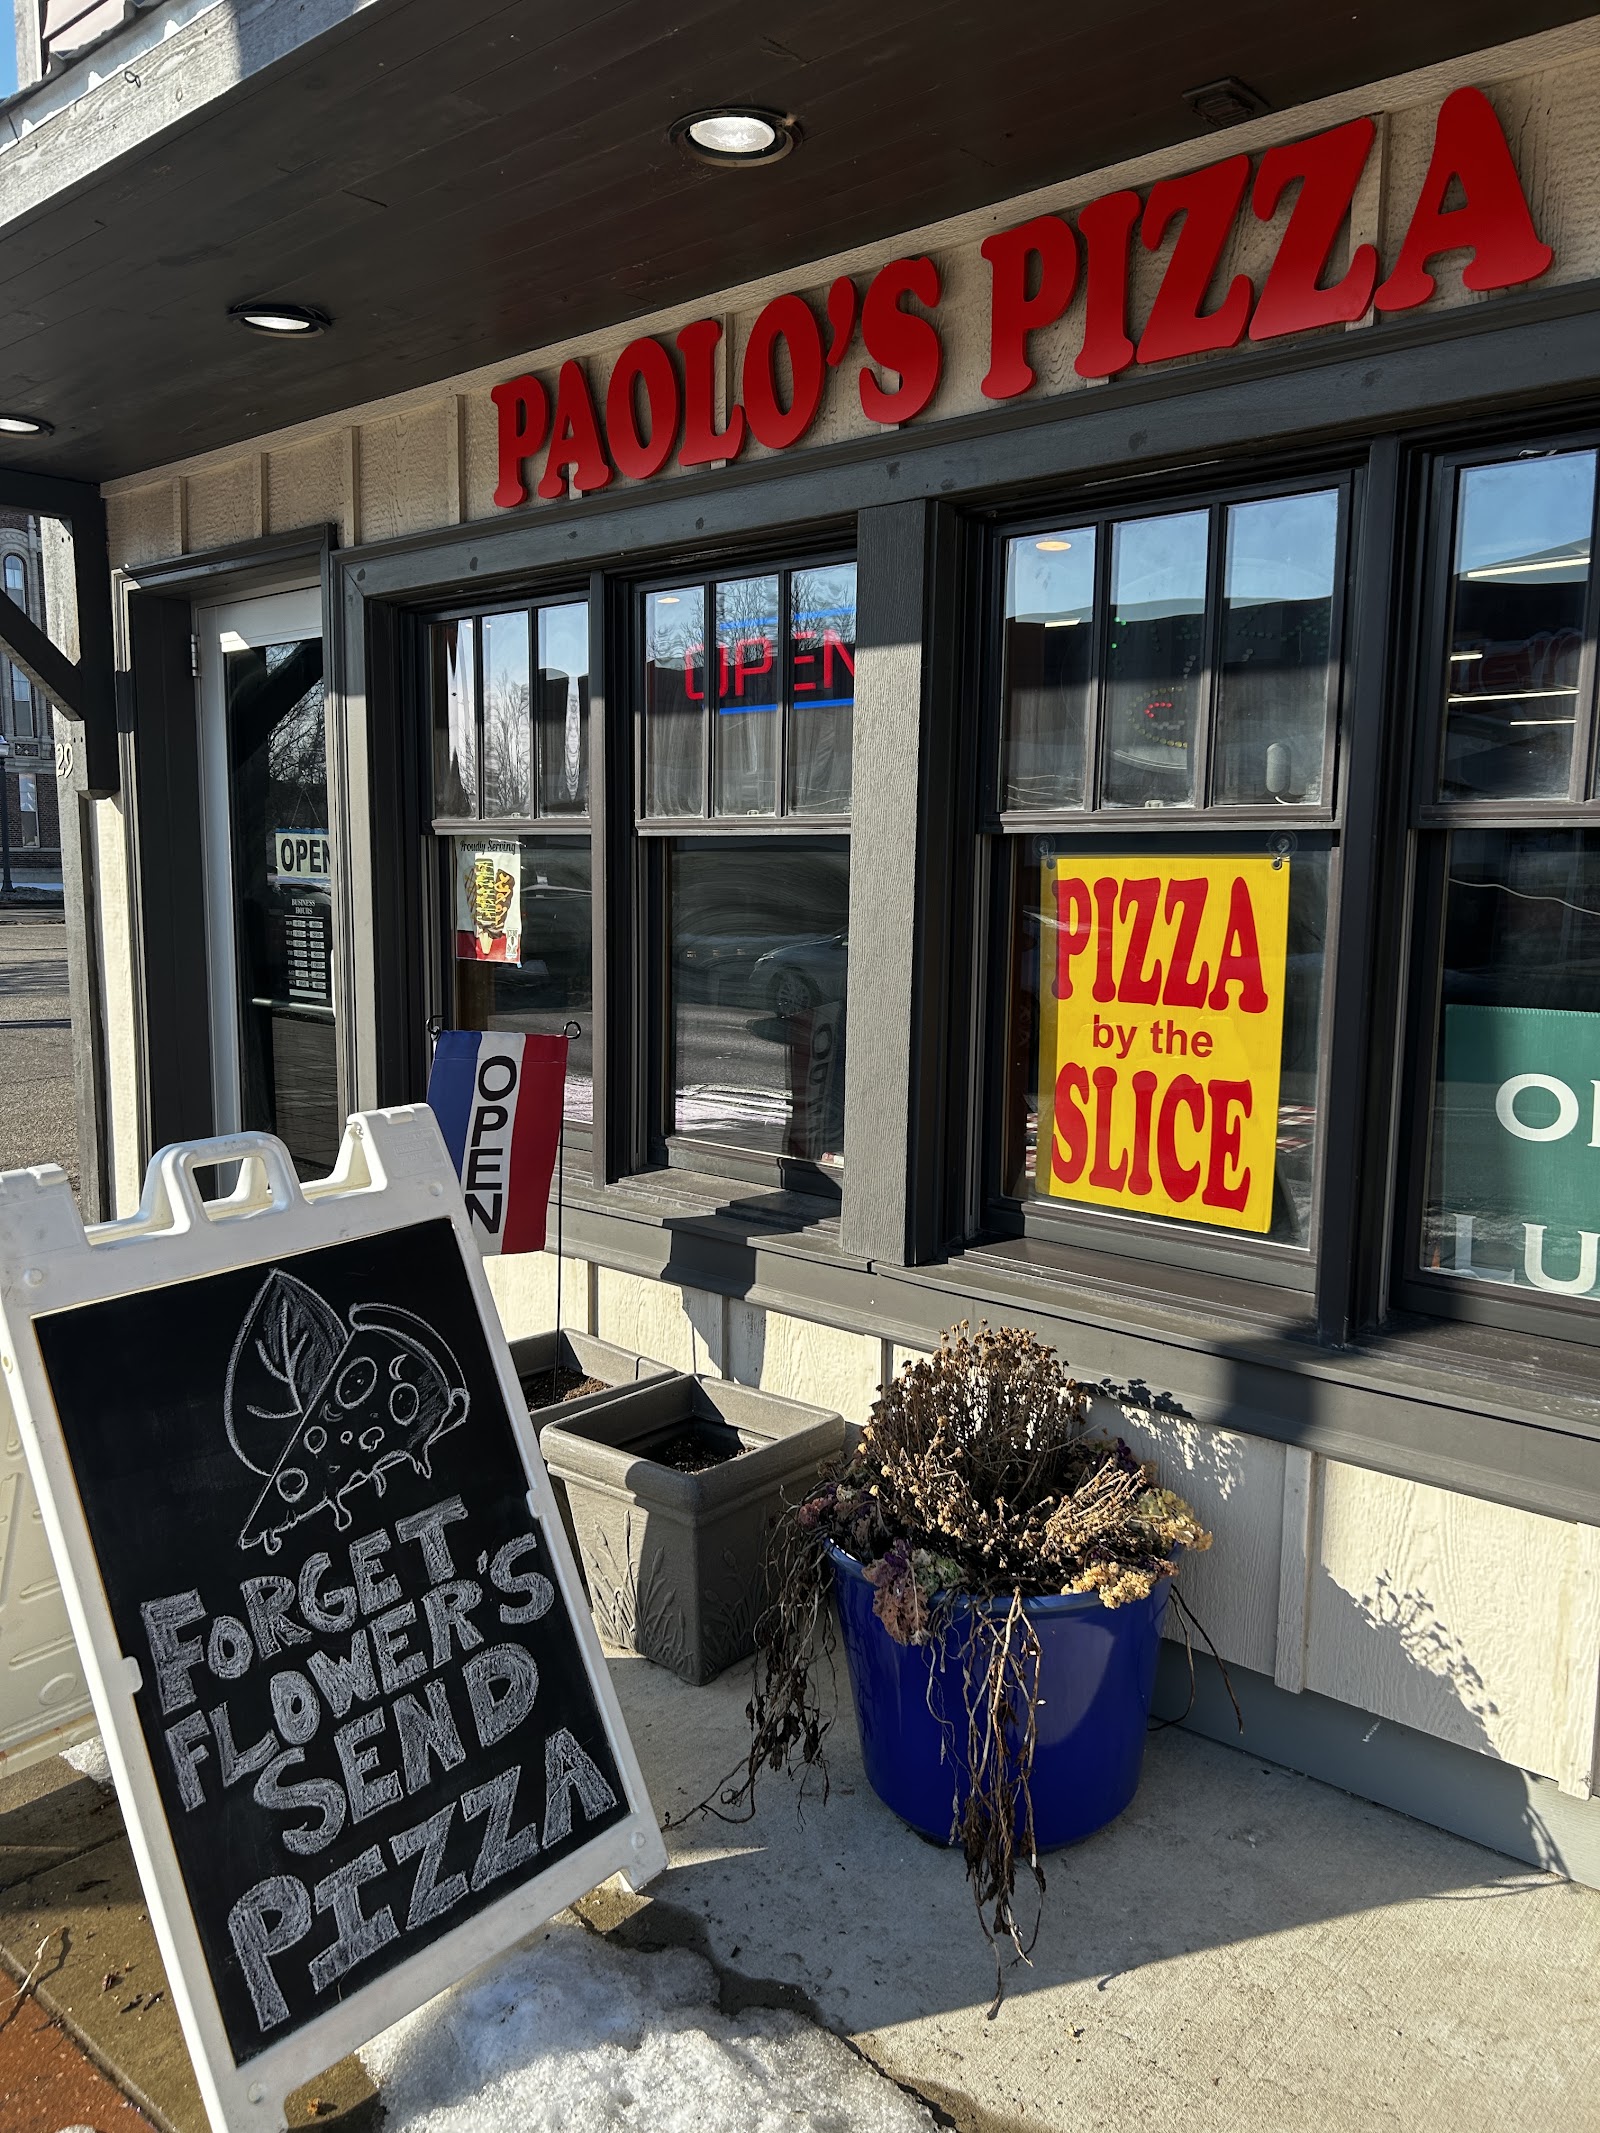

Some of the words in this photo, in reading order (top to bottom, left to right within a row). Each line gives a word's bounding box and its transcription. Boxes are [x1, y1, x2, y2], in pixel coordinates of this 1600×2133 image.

[490, 256, 943, 508] PAOLO'S
[981, 86, 1553, 400] PIZZA
[684, 628, 855, 700] OPEN
[56, 743, 74, 779] 29
[460, 840, 487, 854] Proudly
[487, 840, 516, 855] Serving
[1051, 876, 1269, 1014] PIZZA
[1092, 1014, 1138, 1059] by
[1150, 1020, 1214, 1058] the
[464, 1055, 518, 1234] OPEN
[1051, 1061, 1254, 1213] SLICE
[140, 1494, 469, 1715] FORGET
[165, 1533, 555, 1813] FLOWER'S
[253, 1641, 540, 1856] SEND
[228, 1726, 620, 2032] PIZZA
